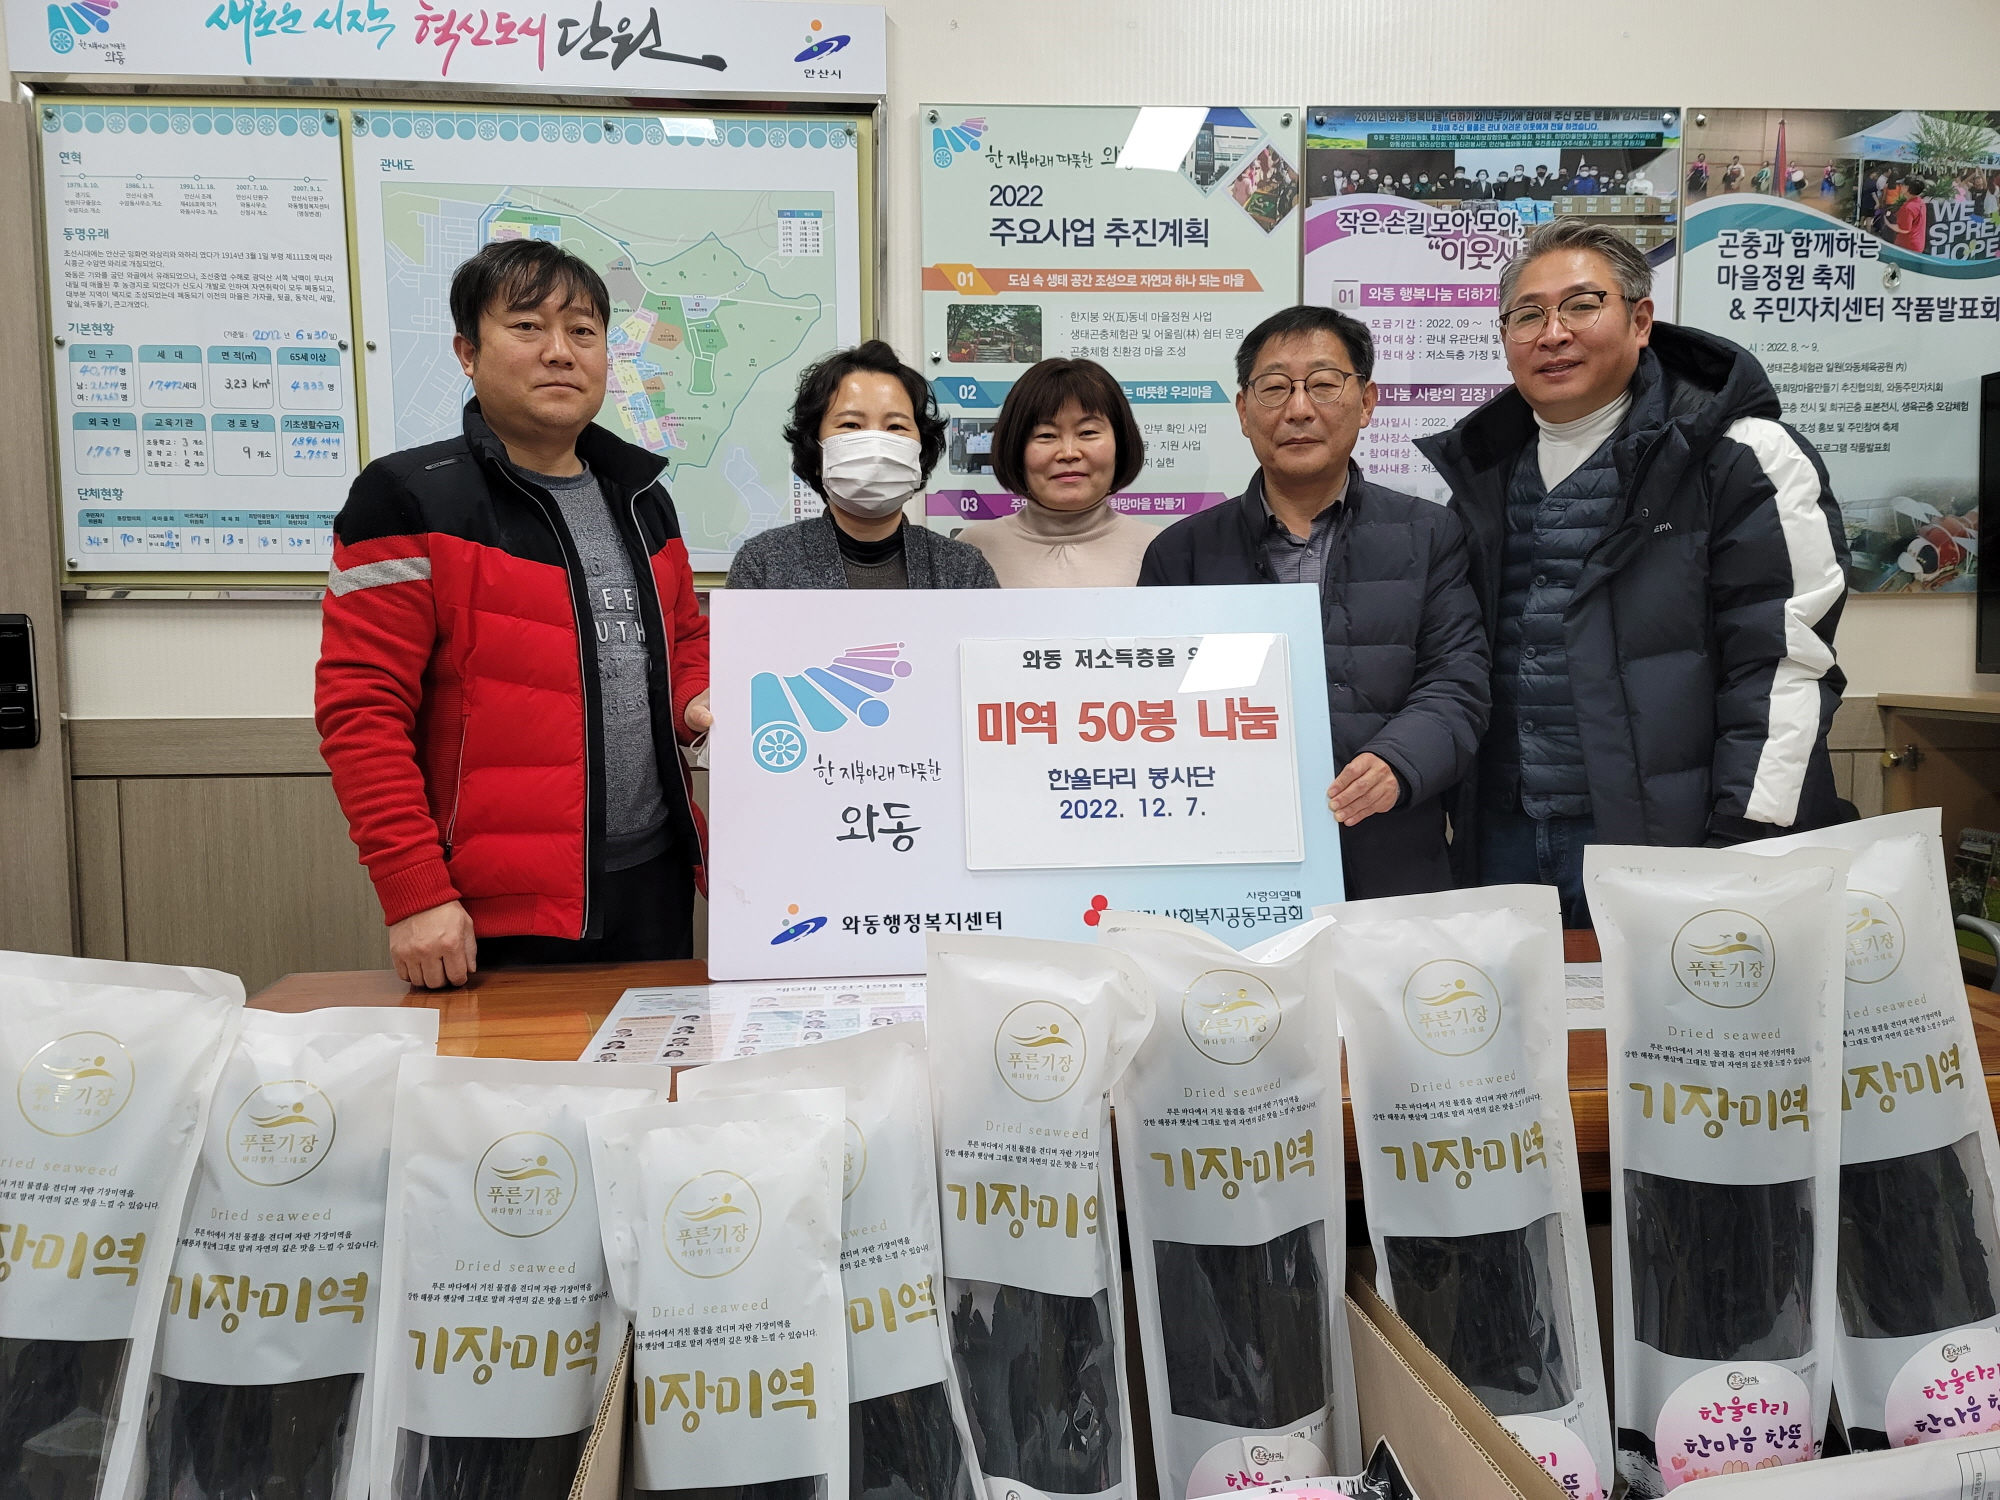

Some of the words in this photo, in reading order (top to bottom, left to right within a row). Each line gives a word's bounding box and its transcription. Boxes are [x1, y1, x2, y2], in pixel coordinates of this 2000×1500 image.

[557, 0, 728, 72] 단원
[104, 51, 126, 65] 와동
[804, 67, 842, 79] 안산시
[1355, 111, 1387, 123] 2021년
[1388, 112, 1407, 122] 와동
[1408, 111, 1442, 123] 행복나눔
[1525, 110, 1550, 122] 참여해
[1553, 110, 1571, 121] 주신
[59, 151, 82, 165] 연혁
[380, 157, 415, 172] 관내도
[985, 145, 1004, 169] 한
[1008, 149, 1054, 169] 지붕아래
[1057, 150, 1094, 169] 따뜻한
[1100, 146, 1133, 170] 와
[989, 184, 1044, 207] 2022
[1933, 200, 1975, 222] WE
[1336, 210, 1381, 235] 작은
[1385, 210, 1427, 236] 손길
[1430, 211, 1473, 235] 모아
[1477, 211, 1523, 236] 모아,
[63, 228, 109, 241] 동명유래
[989, 217, 1095, 248] 주요사업
[1103, 217, 1210, 248] 추진계획
[1717, 231, 1785, 259] 곤충과
[1791, 231, 1880, 259] 함께하는
[1930, 237, 2000, 260] HOPE
[63, 250, 104, 258] 조선시대에는
[105, 250, 126, 258] 안산군
[222, 252, 244, 260] 1914년
[245, 252, 257, 260] 3월
[258, 252, 269, 260] 1일
[319, 253, 333, 262] 따라
[956, 271, 974, 287] 01
[1008, 273, 1030, 288] 도심
[1032, 273, 1045, 288] 속
[1046, 273, 1068, 288] 생태
[1070, 273, 1092, 288] 공간
[1095, 273, 1138, 288] 조성으로
[1140, 273, 1173, 288] 자연과
[1174, 273, 1197, 288] 하나
[1198, 273, 1220, 288] 되는
[1223, 273, 1245, 288] 마을
[1717, 264, 1805, 291] 마을정원
[1812, 264, 1856, 291] 축제
[1338, 288, 1354, 304] 01
[1368, 287, 1395, 301] 와동
[1399, 287, 1453, 301] 행복나눔
[1070, 311, 1100, 323] 한지붕
[1151, 312, 1191, 323] 마을정원
[1193, 312, 1212, 323] 사업
[1729, 299, 1746, 321] &
[1752, 297, 1884, 323] 주민자치센터
[1891, 296, 2000, 323] 작품발표회
[68, 322, 115, 336] 기본현황
[1371, 318, 1416, 329] 모금기간
[1070, 329, 1139, 340] 생태곤충체험관
[1141, 329, 1151, 340] 및
[1202, 329, 1222, 340] 쉼터
[1224, 329, 1245, 340] 운영
[1426, 334, 1445, 345] 관내
[1449, 334, 1489, 345] 유관단체
[289, 353, 309, 362] 65세
[310, 353, 327, 362] 이상
[1070, 346, 1109, 357] 곤충체험
[1112, 346, 1142, 357] 친환경
[1144, 346, 1164, 357] 마을
[1166, 346, 1187, 357] 조성
[1426, 349, 1465, 360] 저소득층
[1468, 349, 1488, 360] 가정
[1766, 362, 1823, 373] 생태곤충체험관
[958, 384, 977, 400] 02
[1136, 385, 1168, 399] 따뜻한
[1170, 385, 1213, 399] 우리마을
[1385, 387, 1412, 402] 나눔
[1415, 387, 1455, 402] 사랑의
[1460, 387, 1487, 402] 김장
[1886, 382, 1944, 393] 와동주민자치회
[1936, 401, 1969, 412] 오감체험
[154, 418, 194, 428] 교육기관
[284, 420, 340, 430] 기초생활수급자
[1143, 424, 1163, 434] 안부
[1166, 424, 1185, 434] 확인
[1188, 424, 1207, 434] 사업
[1370, 417, 1411, 428] 행사일시
[1847, 422, 1880, 433] 주민참여
[1369, 448, 1411, 459] 참여대상
[1850, 442, 1890, 453] 작품발표회
[77, 488, 124, 501] 단체현황
[960, 497, 978, 512] 03
[1110, 497, 1152, 511] 희망마을
[1153, 497, 1186, 511] 만들기
[1022, 648, 1062, 670] 와동
[1074, 647, 1176, 669] 저소득층을
[977, 700, 1058, 745] 미역
[1078, 699, 1178, 743] 50봉
[1197, 697, 1279, 740] 나눔
[813, 754, 835, 785] 한
[839, 760, 895, 784] 지붕아래
[898, 758, 942, 782] 따뜻한
[1047, 767, 1137, 790] 한울타리
[1147, 766, 1216, 789] 봉사단
[1059, 798, 1124, 819] 2022.
[1138, 797, 1172, 818] 12.
[1186, 797, 1206, 817] 7.
[836, 802, 922, 852] 와동
[1246, 890, 1302, 903] 사랑의열매
[842, 910, 1002, 935] 와동행정복지센터
[1687, 960, 1765, 980] 푸른기장
[1667, 1025, 1714, 1040] Dried
[1723, 1027, 1781, 1041] seaweed
[1007, 1052, 1074, 1073] 푸른기장
[1629, 1081, 1810, 1140] 기장미역
[1380, 1120, 1548, 1190] 기장미역
[1150, 1129, 1316, 1200] 기장미역
[486, 1186, 563, 1206] 푸른기장
[454, 1259, 501, 1273] Dried
[509, 1261, 577, 1274] seaweed
[432, 1282, 446, 1291] 푸른
[448, 1282, 478, 1292] 바다에서
[479, 1283, 495, 1292] 거친
[496, 1283, 518, 1293] 물결을
[543, 1283, 558, 1293] 자란
[408, 1320, 602, 1385] 기장미역
[1698, 1395, 1789, 1424] 한울타리
[1683, 1426, 1757, 1458] 한마음
[1765, 1424, 1802, 1449] 한뜻
